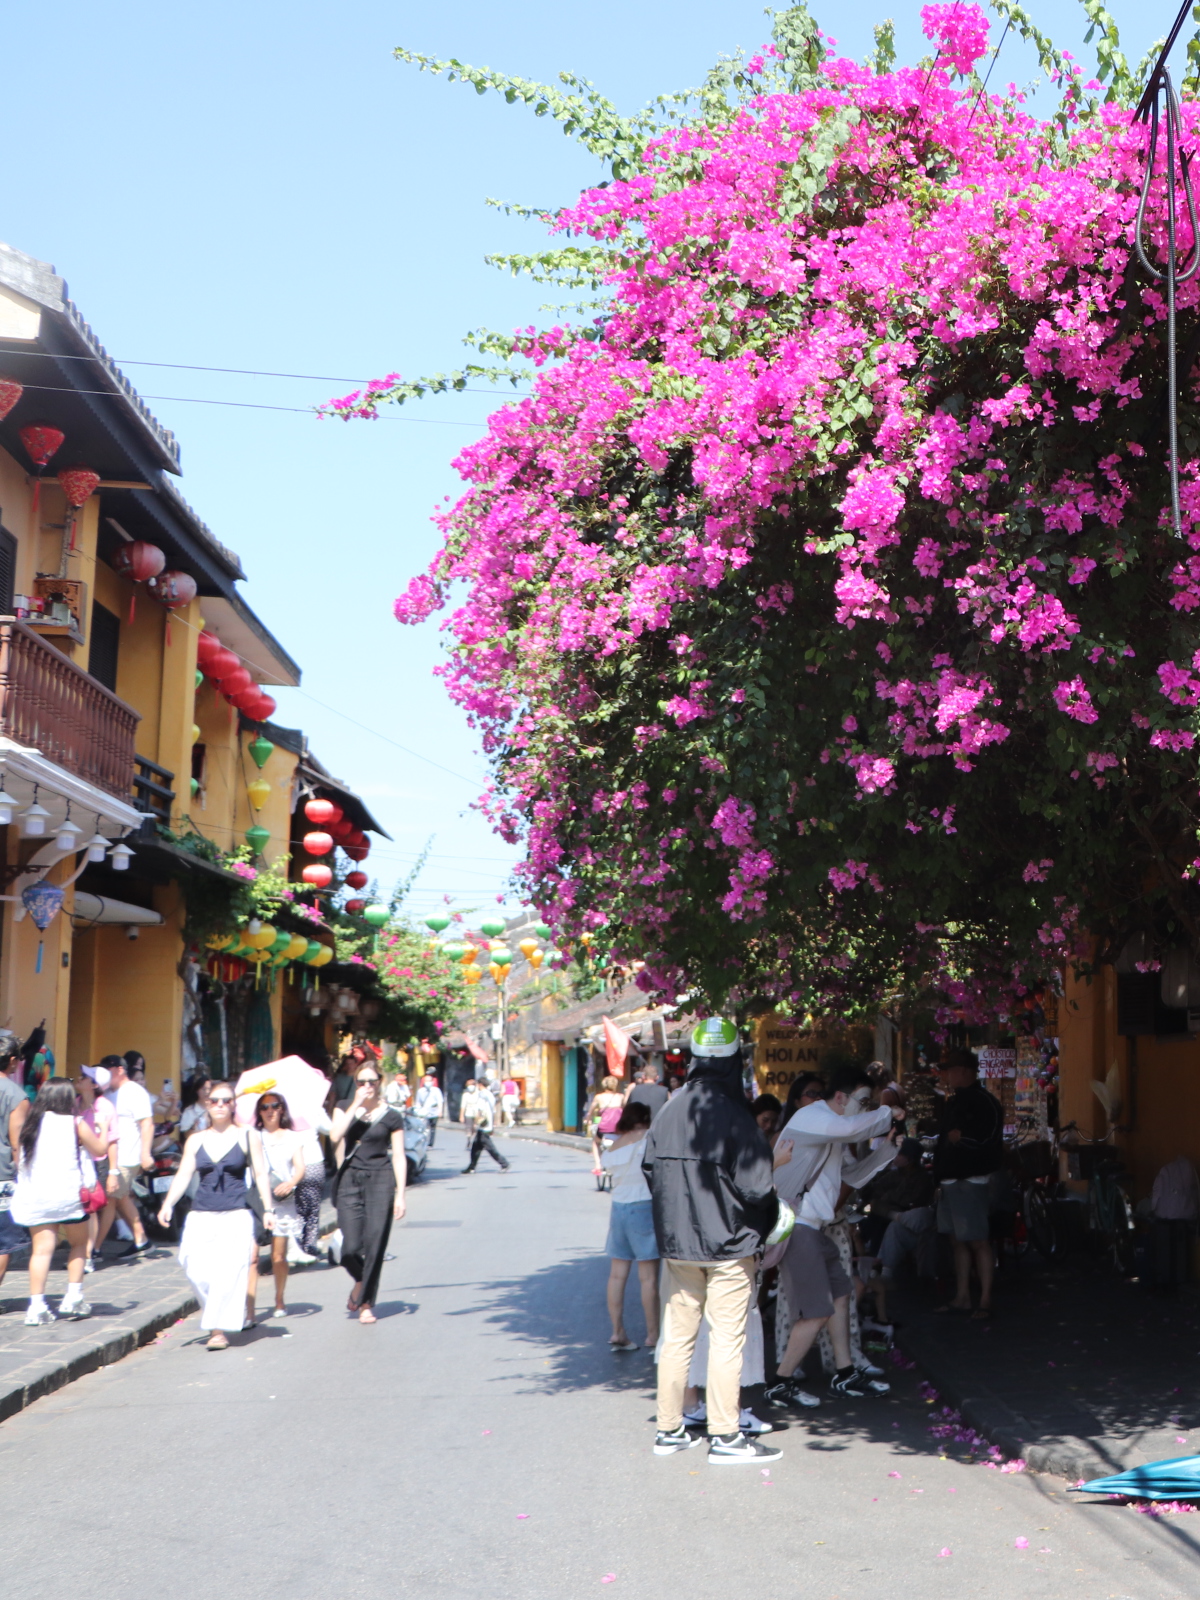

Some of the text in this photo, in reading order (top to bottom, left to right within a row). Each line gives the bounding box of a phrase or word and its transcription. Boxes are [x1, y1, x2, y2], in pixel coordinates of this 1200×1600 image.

[766, 1048, 819, 1062] HOI AN
[985, 1068, 1009, 1078] NAME
